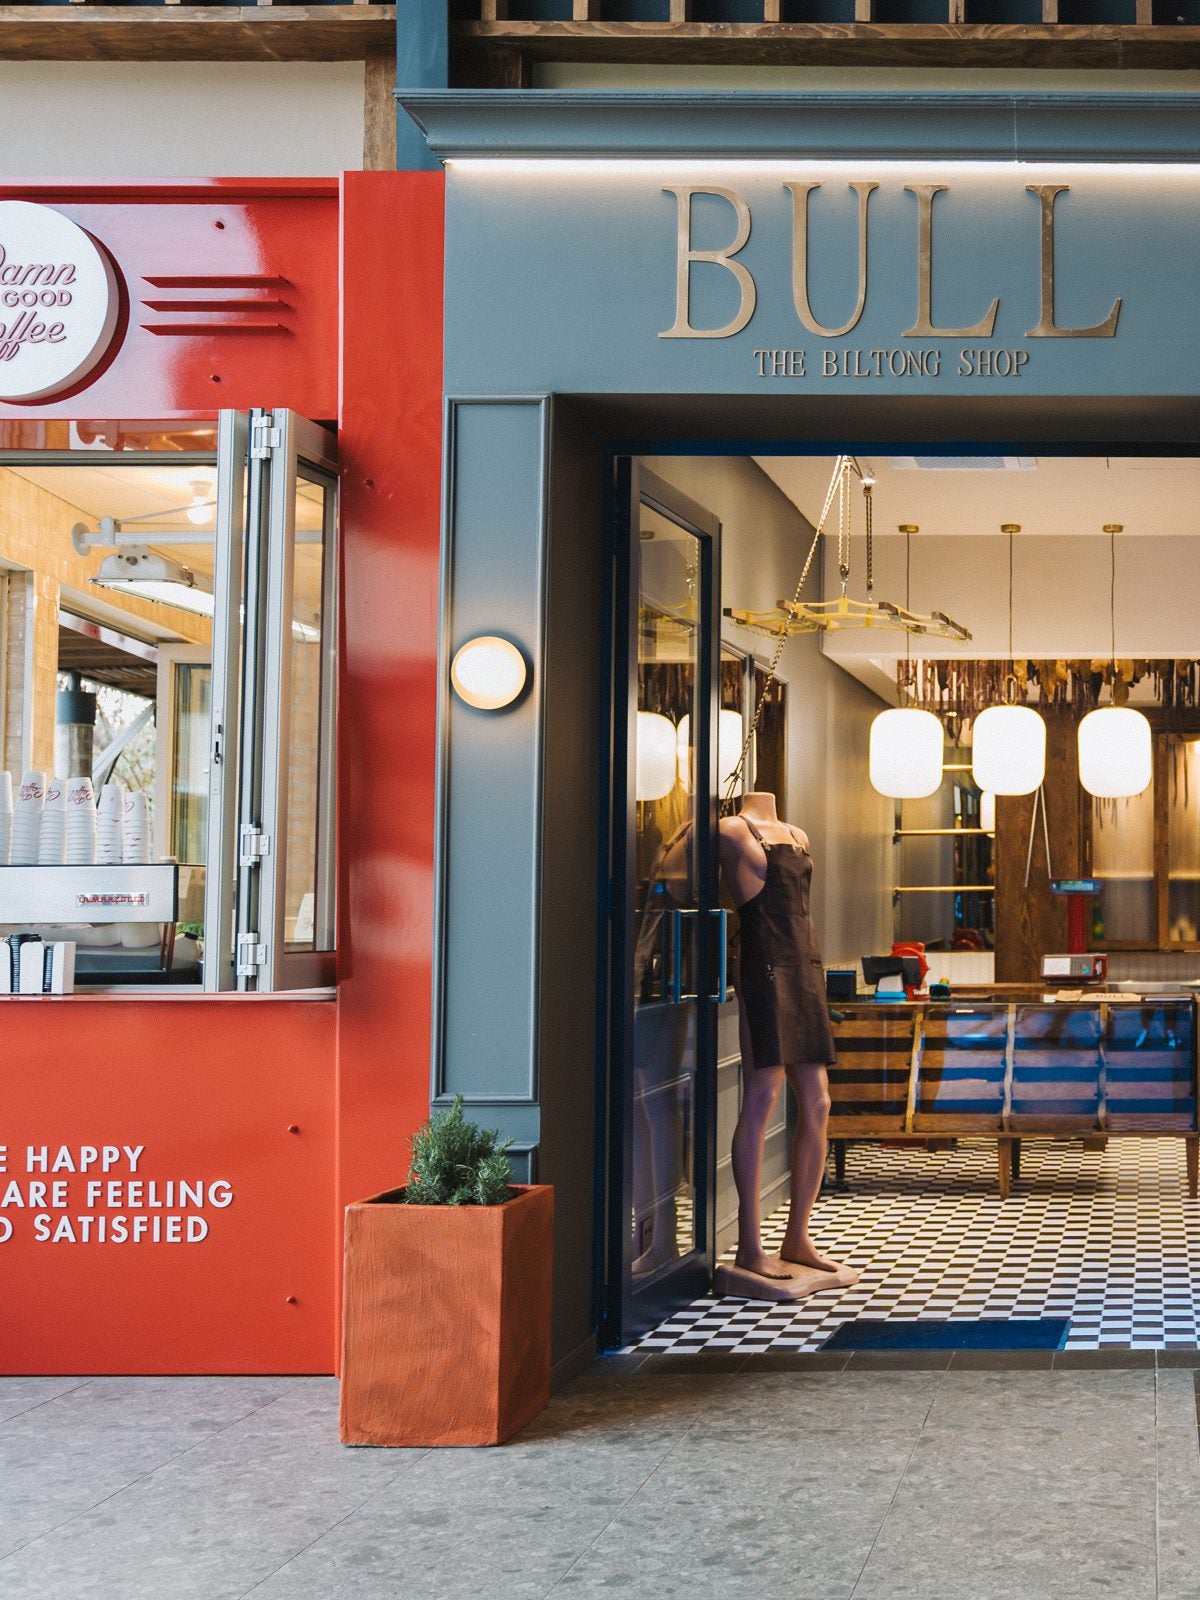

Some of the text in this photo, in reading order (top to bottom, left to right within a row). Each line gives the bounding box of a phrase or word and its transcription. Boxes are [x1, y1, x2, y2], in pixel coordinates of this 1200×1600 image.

[658, 181, 1122, 338] BULL
[3, 289, 72, 307] GOOD
[753, 349, 1030, 378] THE BILTONG SHOP
[26, 1145, 145, 1173] HAPPY
[1, 1179, 234, 1209] ARE FEELING
[34, 1213, 209, 1244] SATISFIED
